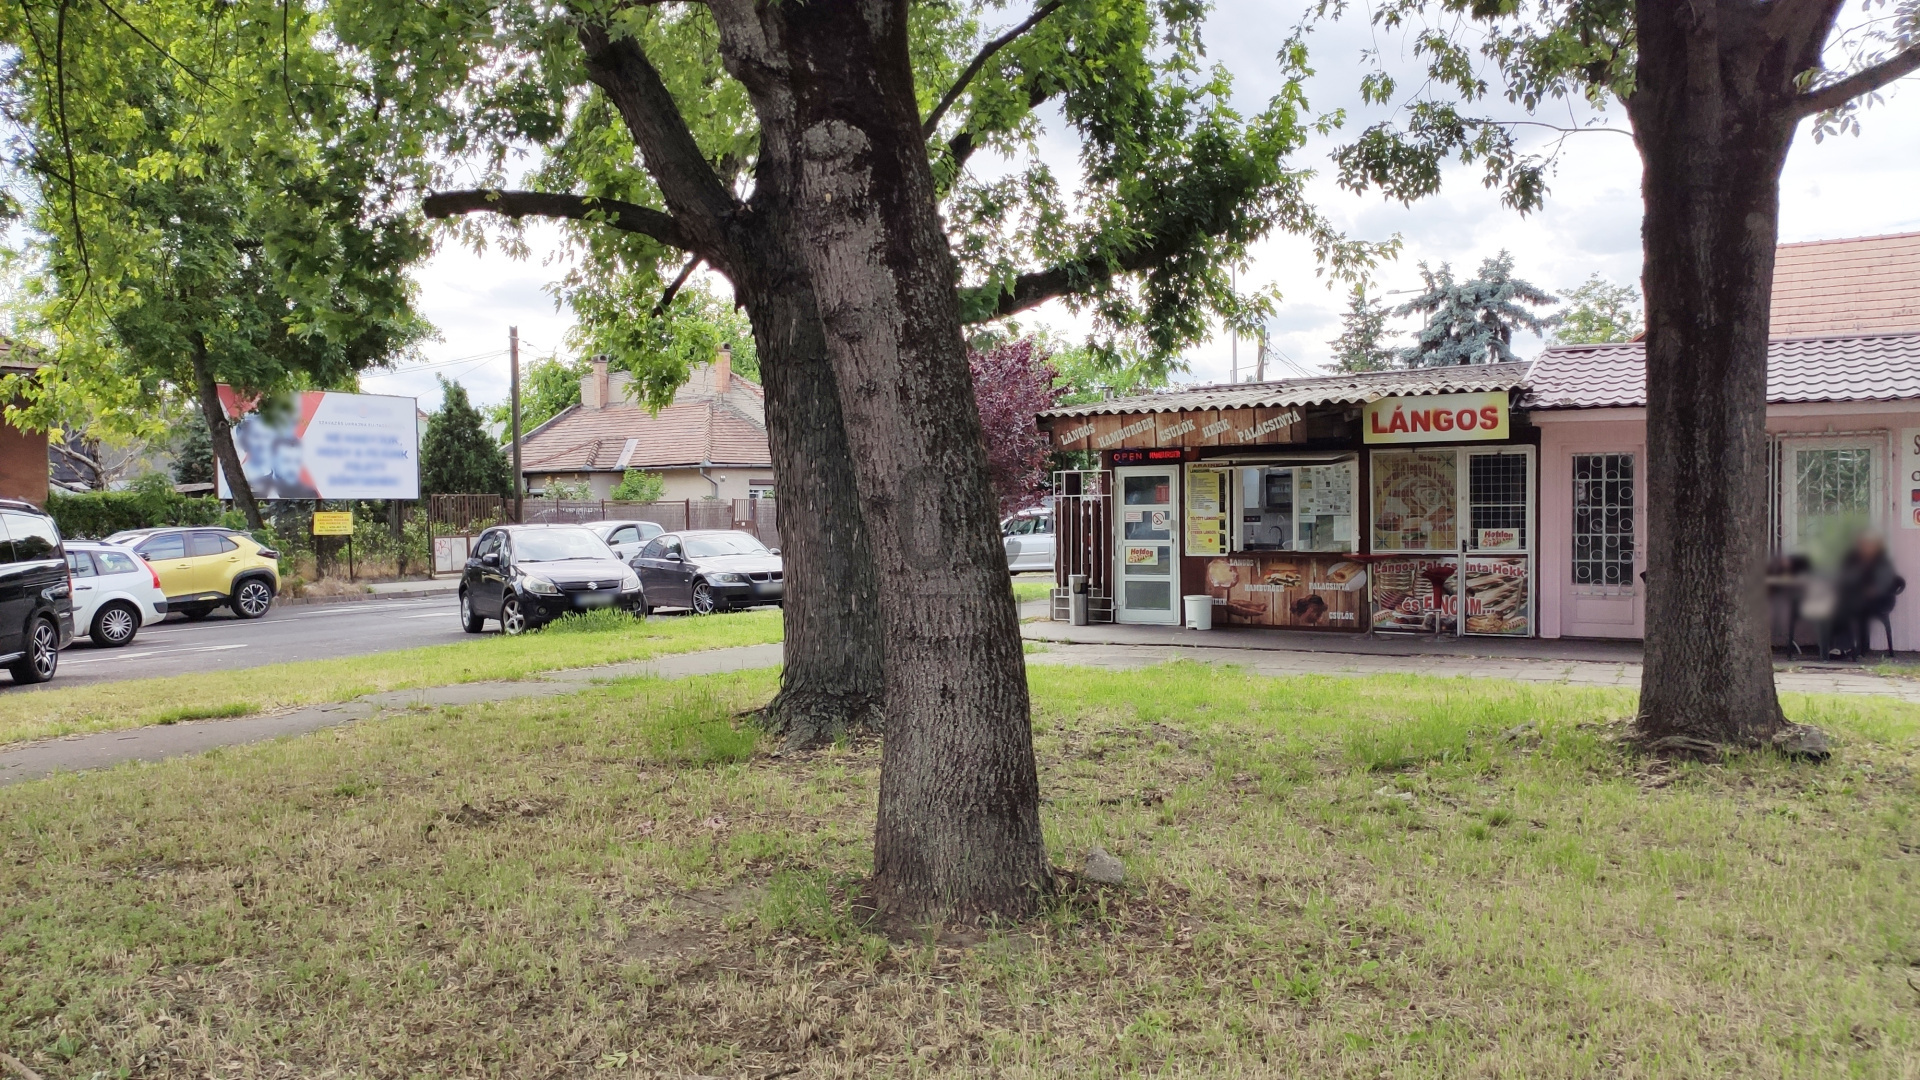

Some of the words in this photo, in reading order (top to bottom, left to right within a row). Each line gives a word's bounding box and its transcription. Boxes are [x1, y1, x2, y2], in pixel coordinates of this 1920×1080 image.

[1371, 404, 1499, 434] LÁNGOS
[1060, 423, 1096, 446] LÁNGOS
[1098, 417, 1155, 448] HAMBURGER
[1159, 419, 1196, 442] CSÜLÖK
[1202, 419, 1231, 438] HEKK
[1237, 410, 1301, 443] PALACSINTA
[1113, 453, 1142, 461] OPEN
[1130, 548, 1154, 557] Hotdog
[1374, 562, 1415, 574] Lángos
[1492, 564, 1524, 577] Hekk
[1244, 584, 1285, 592] HAMBURGER
[1309, 582, 1350, 590] PALACSINTA
[1402, 598, 1420, 612] és
[1424, 596, 1495, 615] FNOM...
